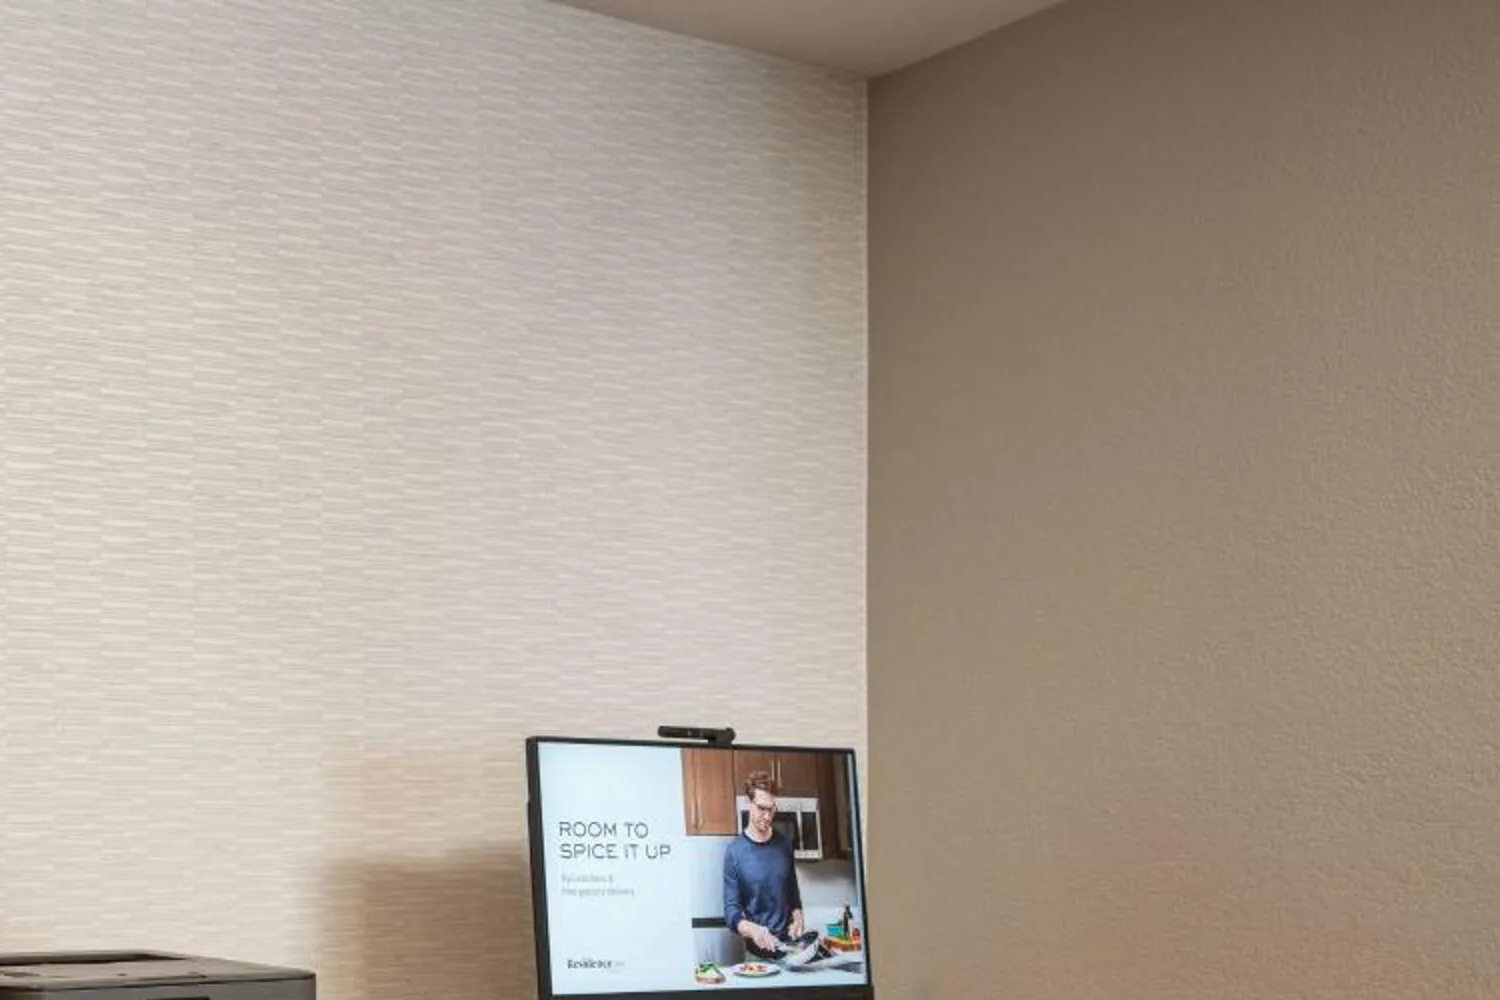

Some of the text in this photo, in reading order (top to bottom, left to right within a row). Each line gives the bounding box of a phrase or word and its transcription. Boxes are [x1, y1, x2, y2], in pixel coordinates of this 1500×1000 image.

[559, 820, 649, 840] ROOM TO
[559, 842, 672, 860] SPICE IT UP
